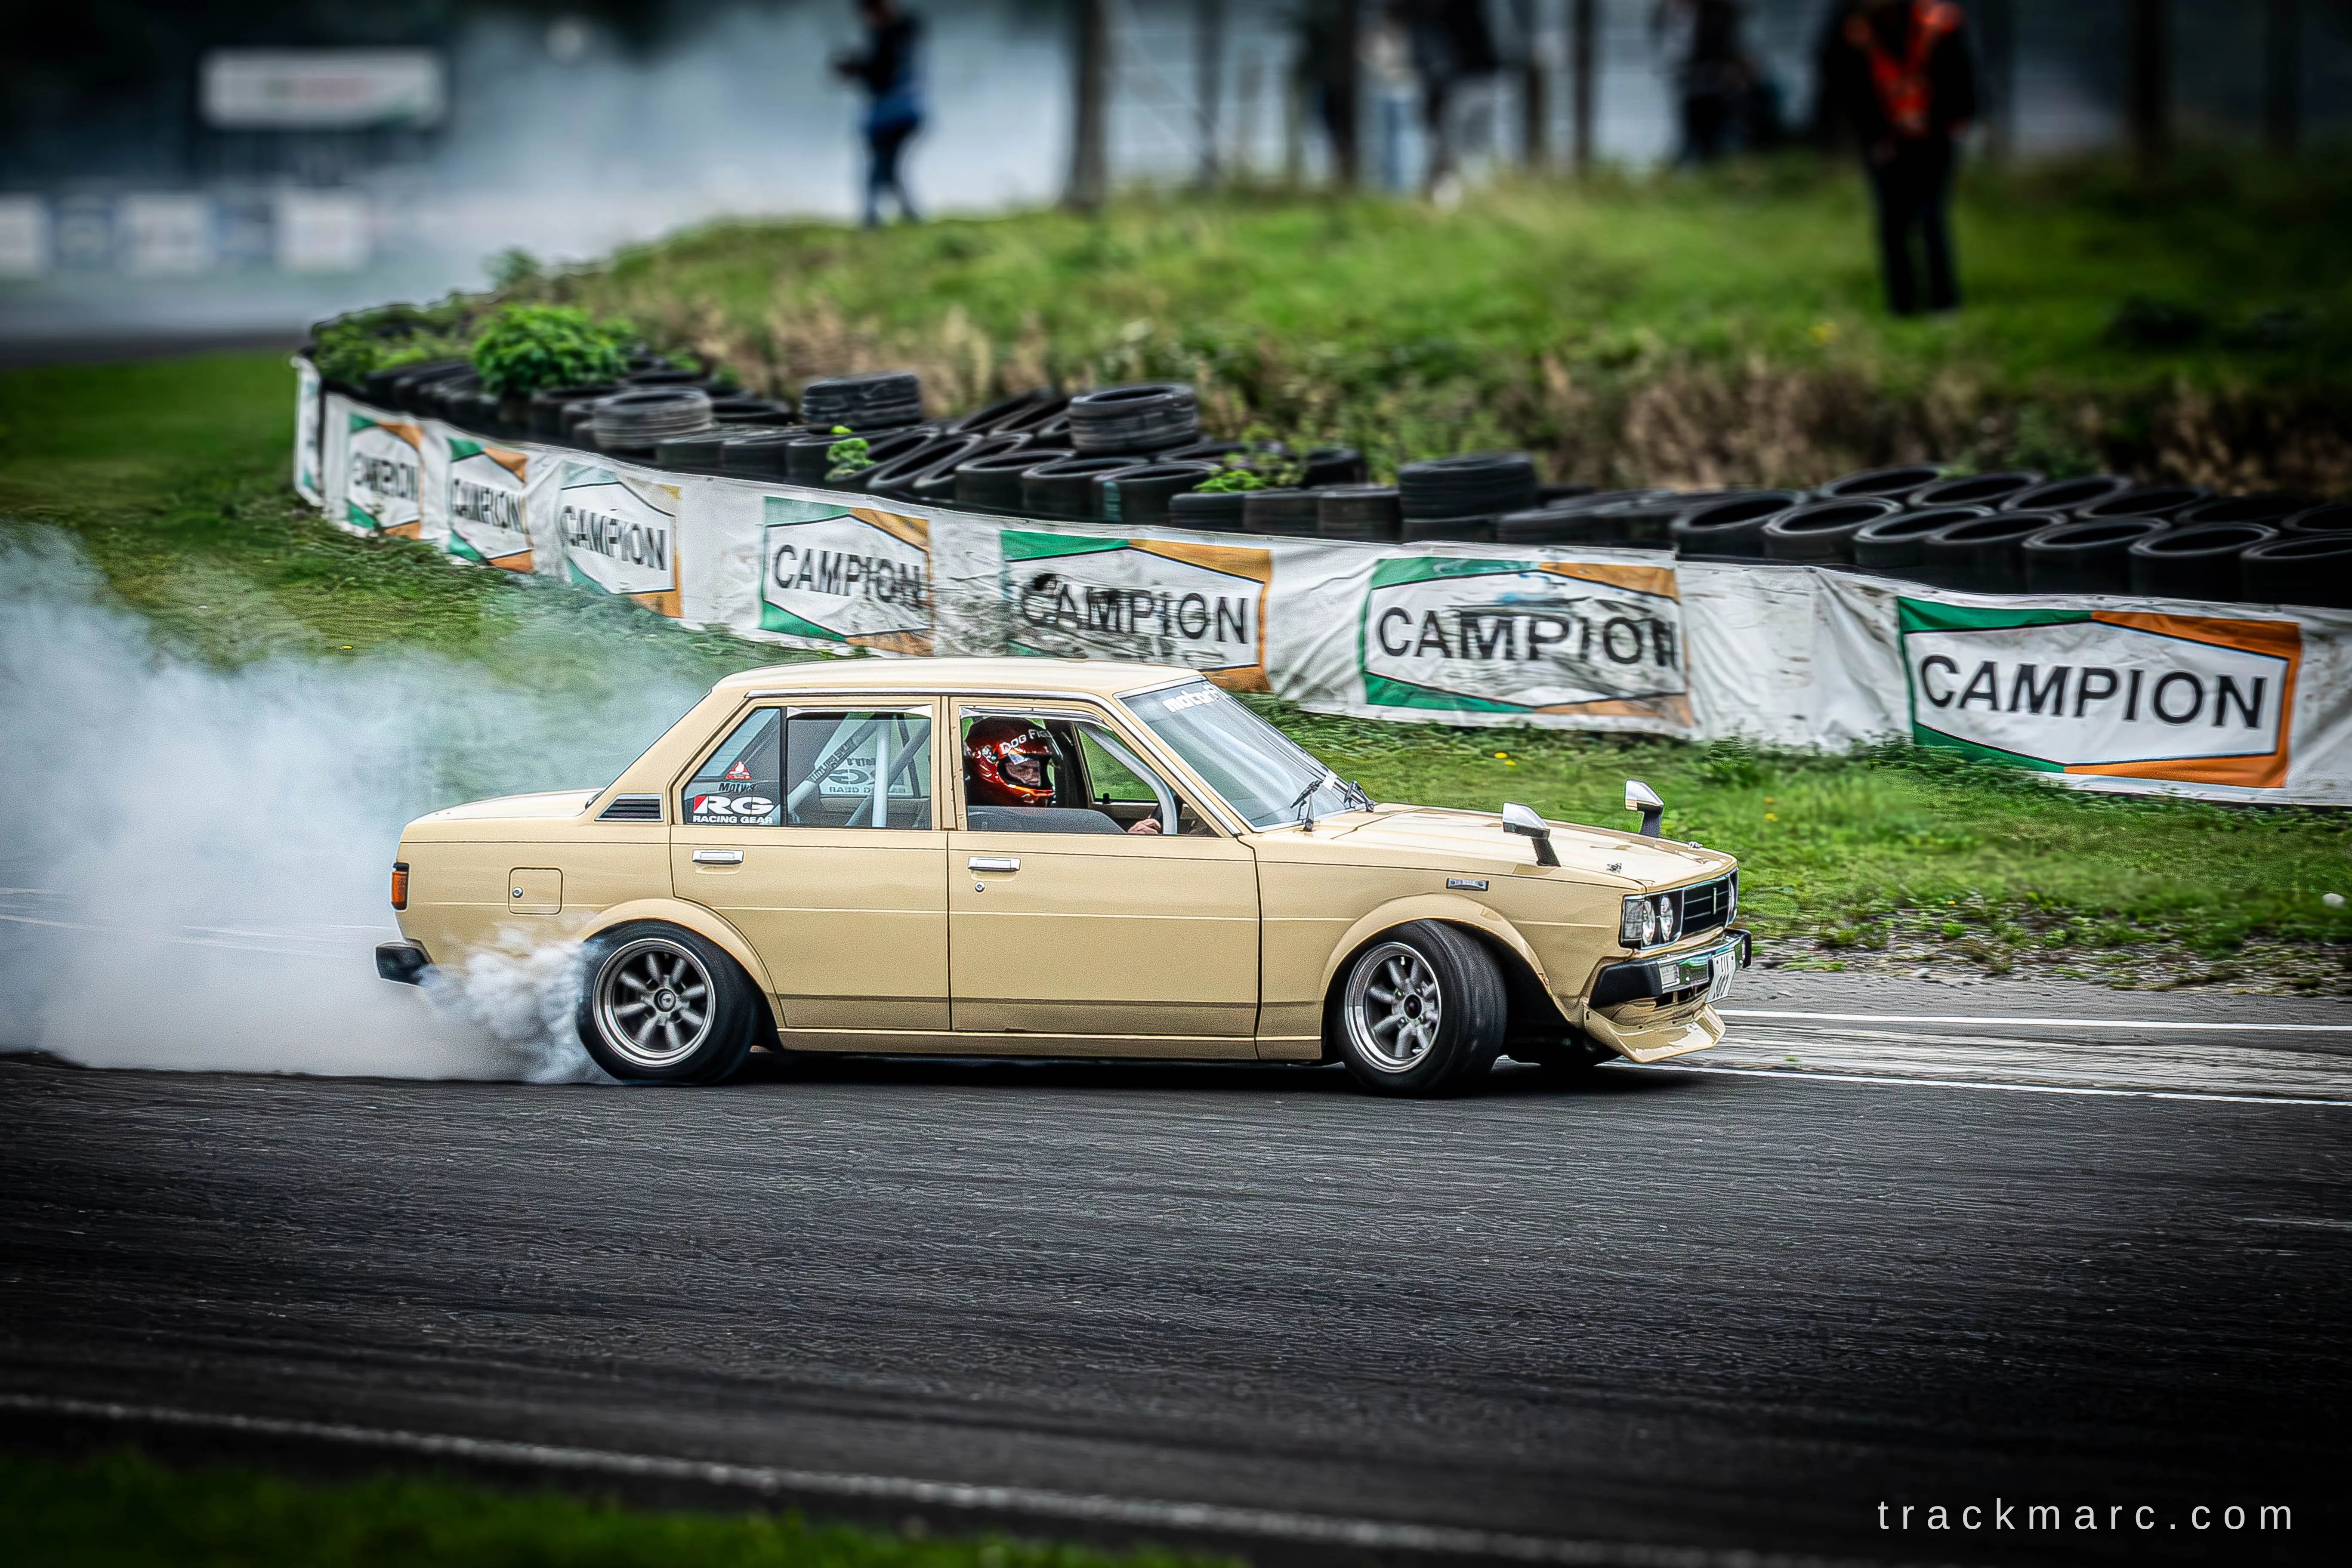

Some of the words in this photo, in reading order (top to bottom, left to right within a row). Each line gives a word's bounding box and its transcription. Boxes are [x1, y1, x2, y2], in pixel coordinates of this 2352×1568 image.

[560, 505, 667, 571] CAMPION
[775, 544, 920, 605] CAMPION
[1022, 575, 1249, 644] CAMPION
[1379, 607, 1676, 670] CAMPION
[1920, 655, 2266, 729] CAMPION
[1000, 734, 1027, 754] DOG
[693, 796, 775, 815] RG
[693, 815, 738, 823] RACING
[740, 815, 773, 824] GEAR
